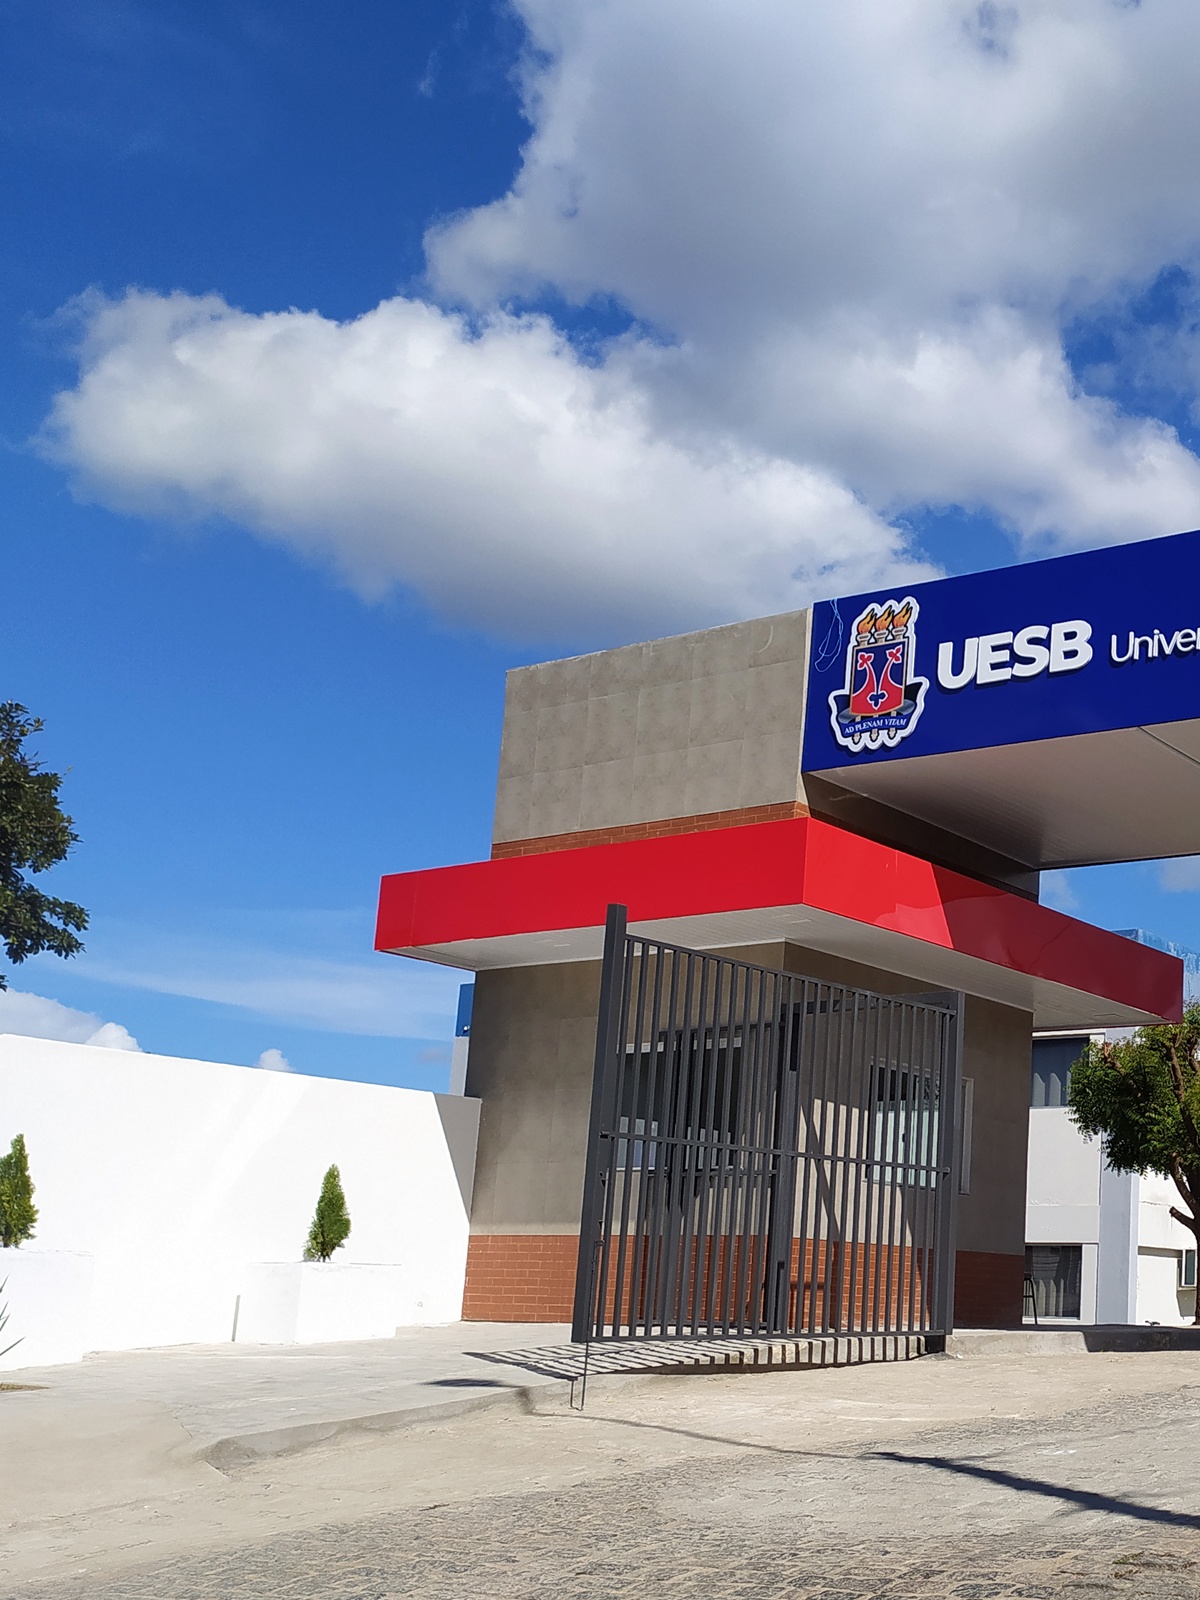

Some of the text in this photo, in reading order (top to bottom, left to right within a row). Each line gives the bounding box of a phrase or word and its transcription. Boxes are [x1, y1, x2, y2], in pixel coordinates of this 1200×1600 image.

[937, 620, 1094, 689] UESB
[844, 718, 907, 734] AD PLENAM VITAM
